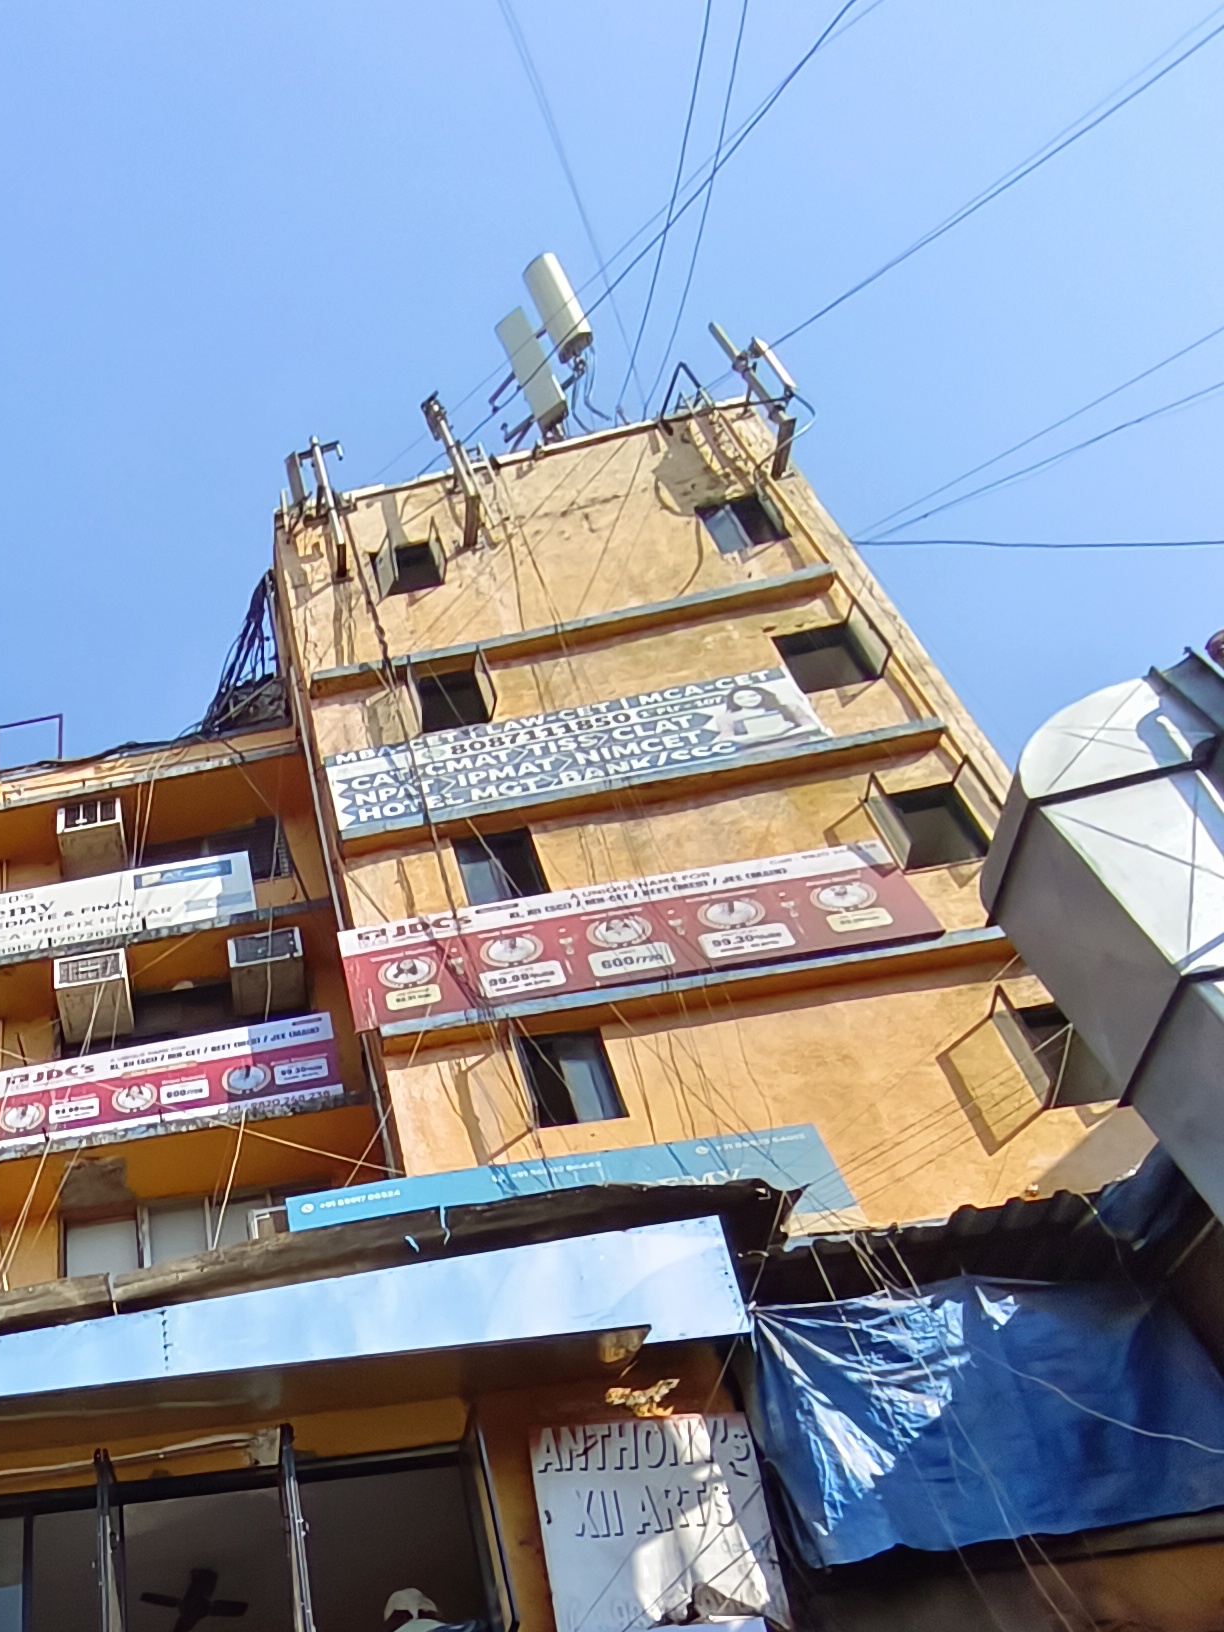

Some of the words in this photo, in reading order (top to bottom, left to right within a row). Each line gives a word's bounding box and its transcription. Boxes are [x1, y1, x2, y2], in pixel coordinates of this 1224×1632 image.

[485, 702, 610, 738] LAW-CET
[639, 670, 770, 706] MCA-CET
[425, 750, 511, 776] CMAT
[526, 733, 599, 757] TISS
[612, 714, 693, 740] CLAT
[458, 759, 553, 788] IPMAT
[575, 730, 702, 765] NIMCET
[81, 899, 133, 915] FINAL
